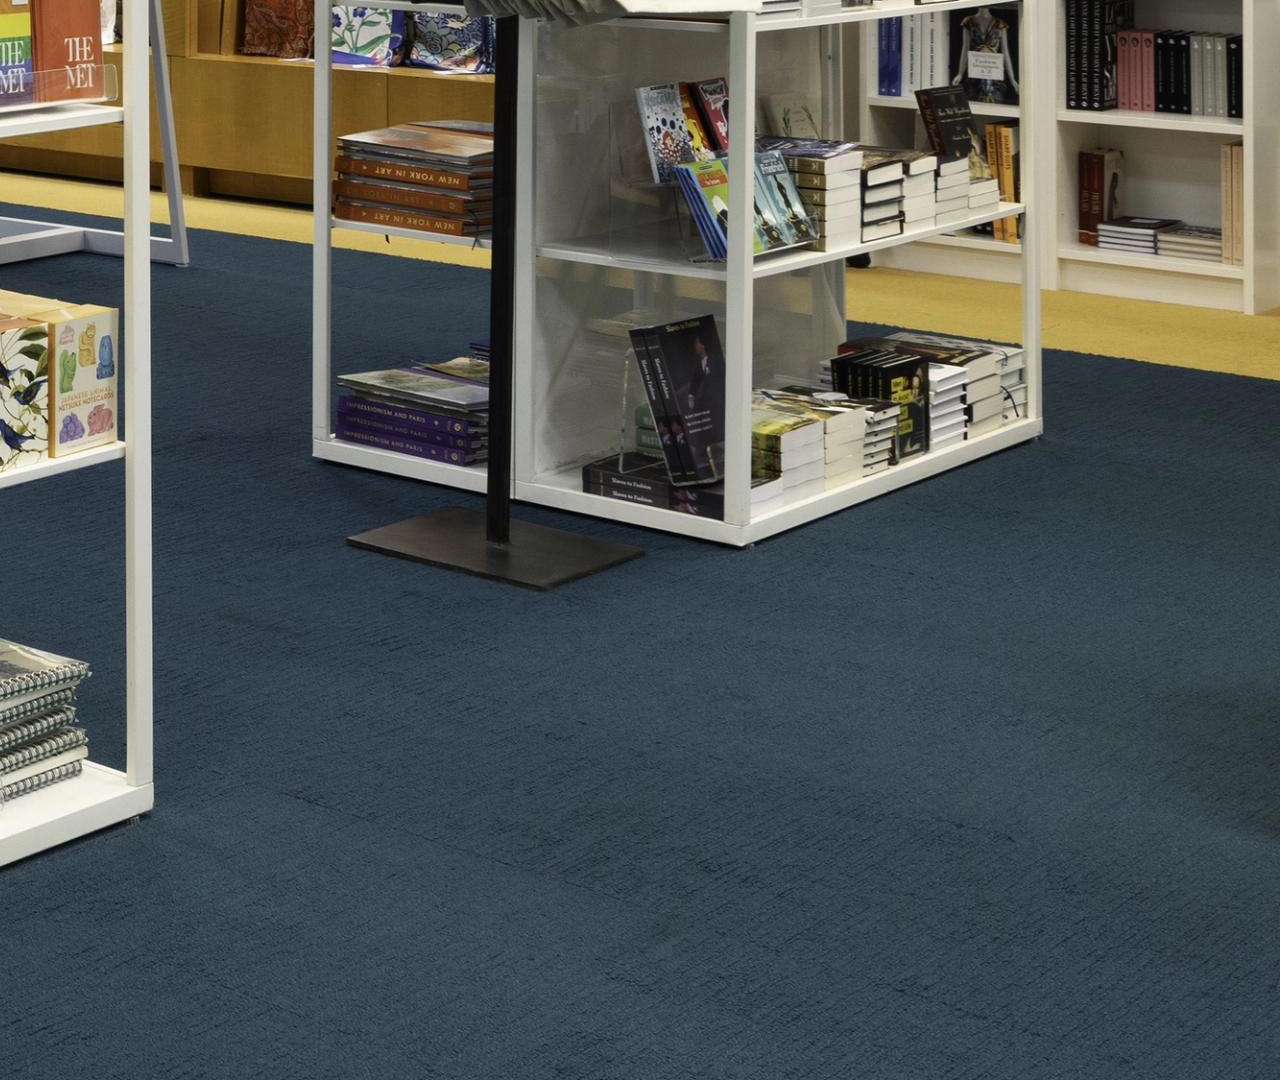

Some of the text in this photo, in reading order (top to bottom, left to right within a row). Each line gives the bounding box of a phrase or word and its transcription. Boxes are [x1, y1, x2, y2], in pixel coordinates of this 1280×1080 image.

[65, 37, 94, 62] THE
[65, 64, 94, 90] MET
[375, 167, 392, 175] ART
[410, 171, 434, 181] YORK
[438, 175, 460, 185] NEW
[374, 213, 455, 230] NEW YORK IN ART
[59, 392, 114, 411] NETSUKE NOTECARDS
[346, 402, 392, 417] IMPRESSIONISM
[409, 414, 426, 423] PARIS
[344, 430, 389, 445] IMPRESSIONISM
[406, 443, 423, 452] PARIS
[611, 477, 626, 485] Slaves
[632, 481, 652, 490] Fashion
[612, 490, 626, 498] Slaves
[632, 494, 653, 503] Fashion
